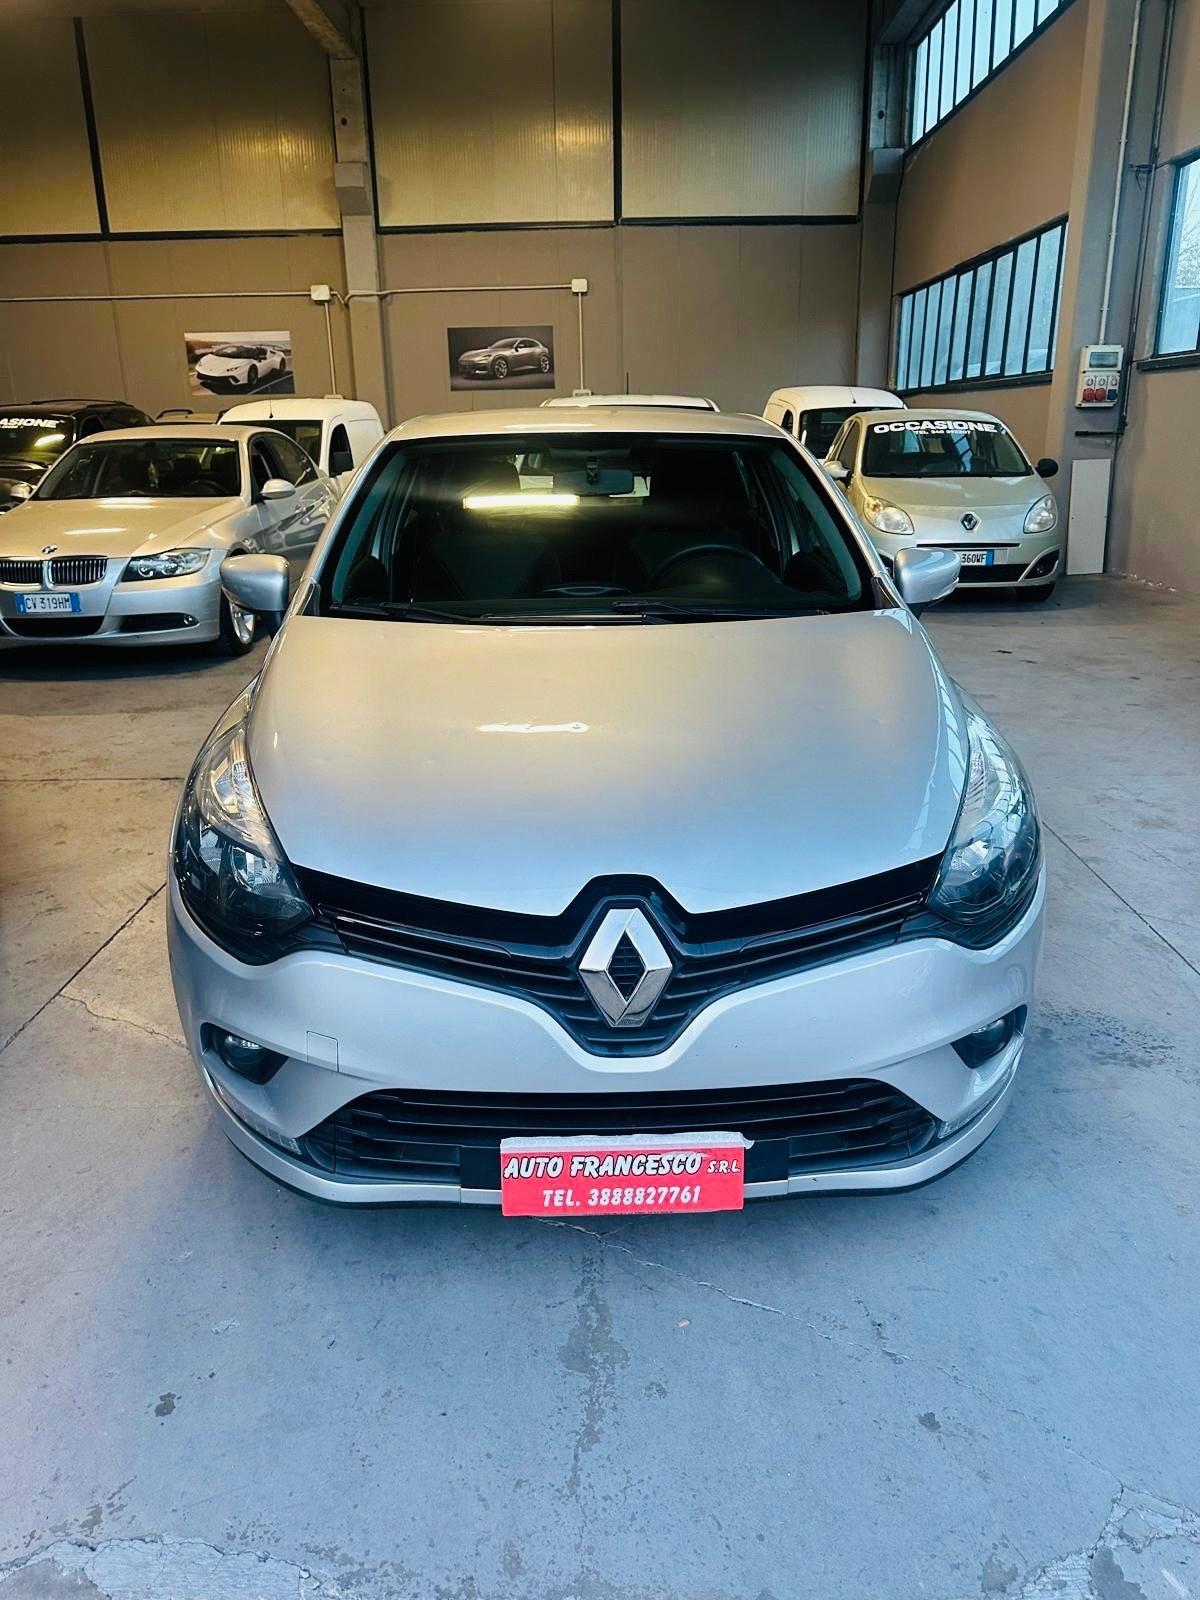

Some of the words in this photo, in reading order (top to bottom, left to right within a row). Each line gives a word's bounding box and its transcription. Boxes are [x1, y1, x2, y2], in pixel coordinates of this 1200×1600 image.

[873, 421, 998, 434] OCCASIONE
[504, 1156, 563, 1179] AUTO
[570, 1153, 702, 1179] FRANCESCO
[707, 1160, 741, 1174] S.R.L.
[543, 1189, 580, 1208] TEL.
[588, 1186, 701, 1207] 3888827761
